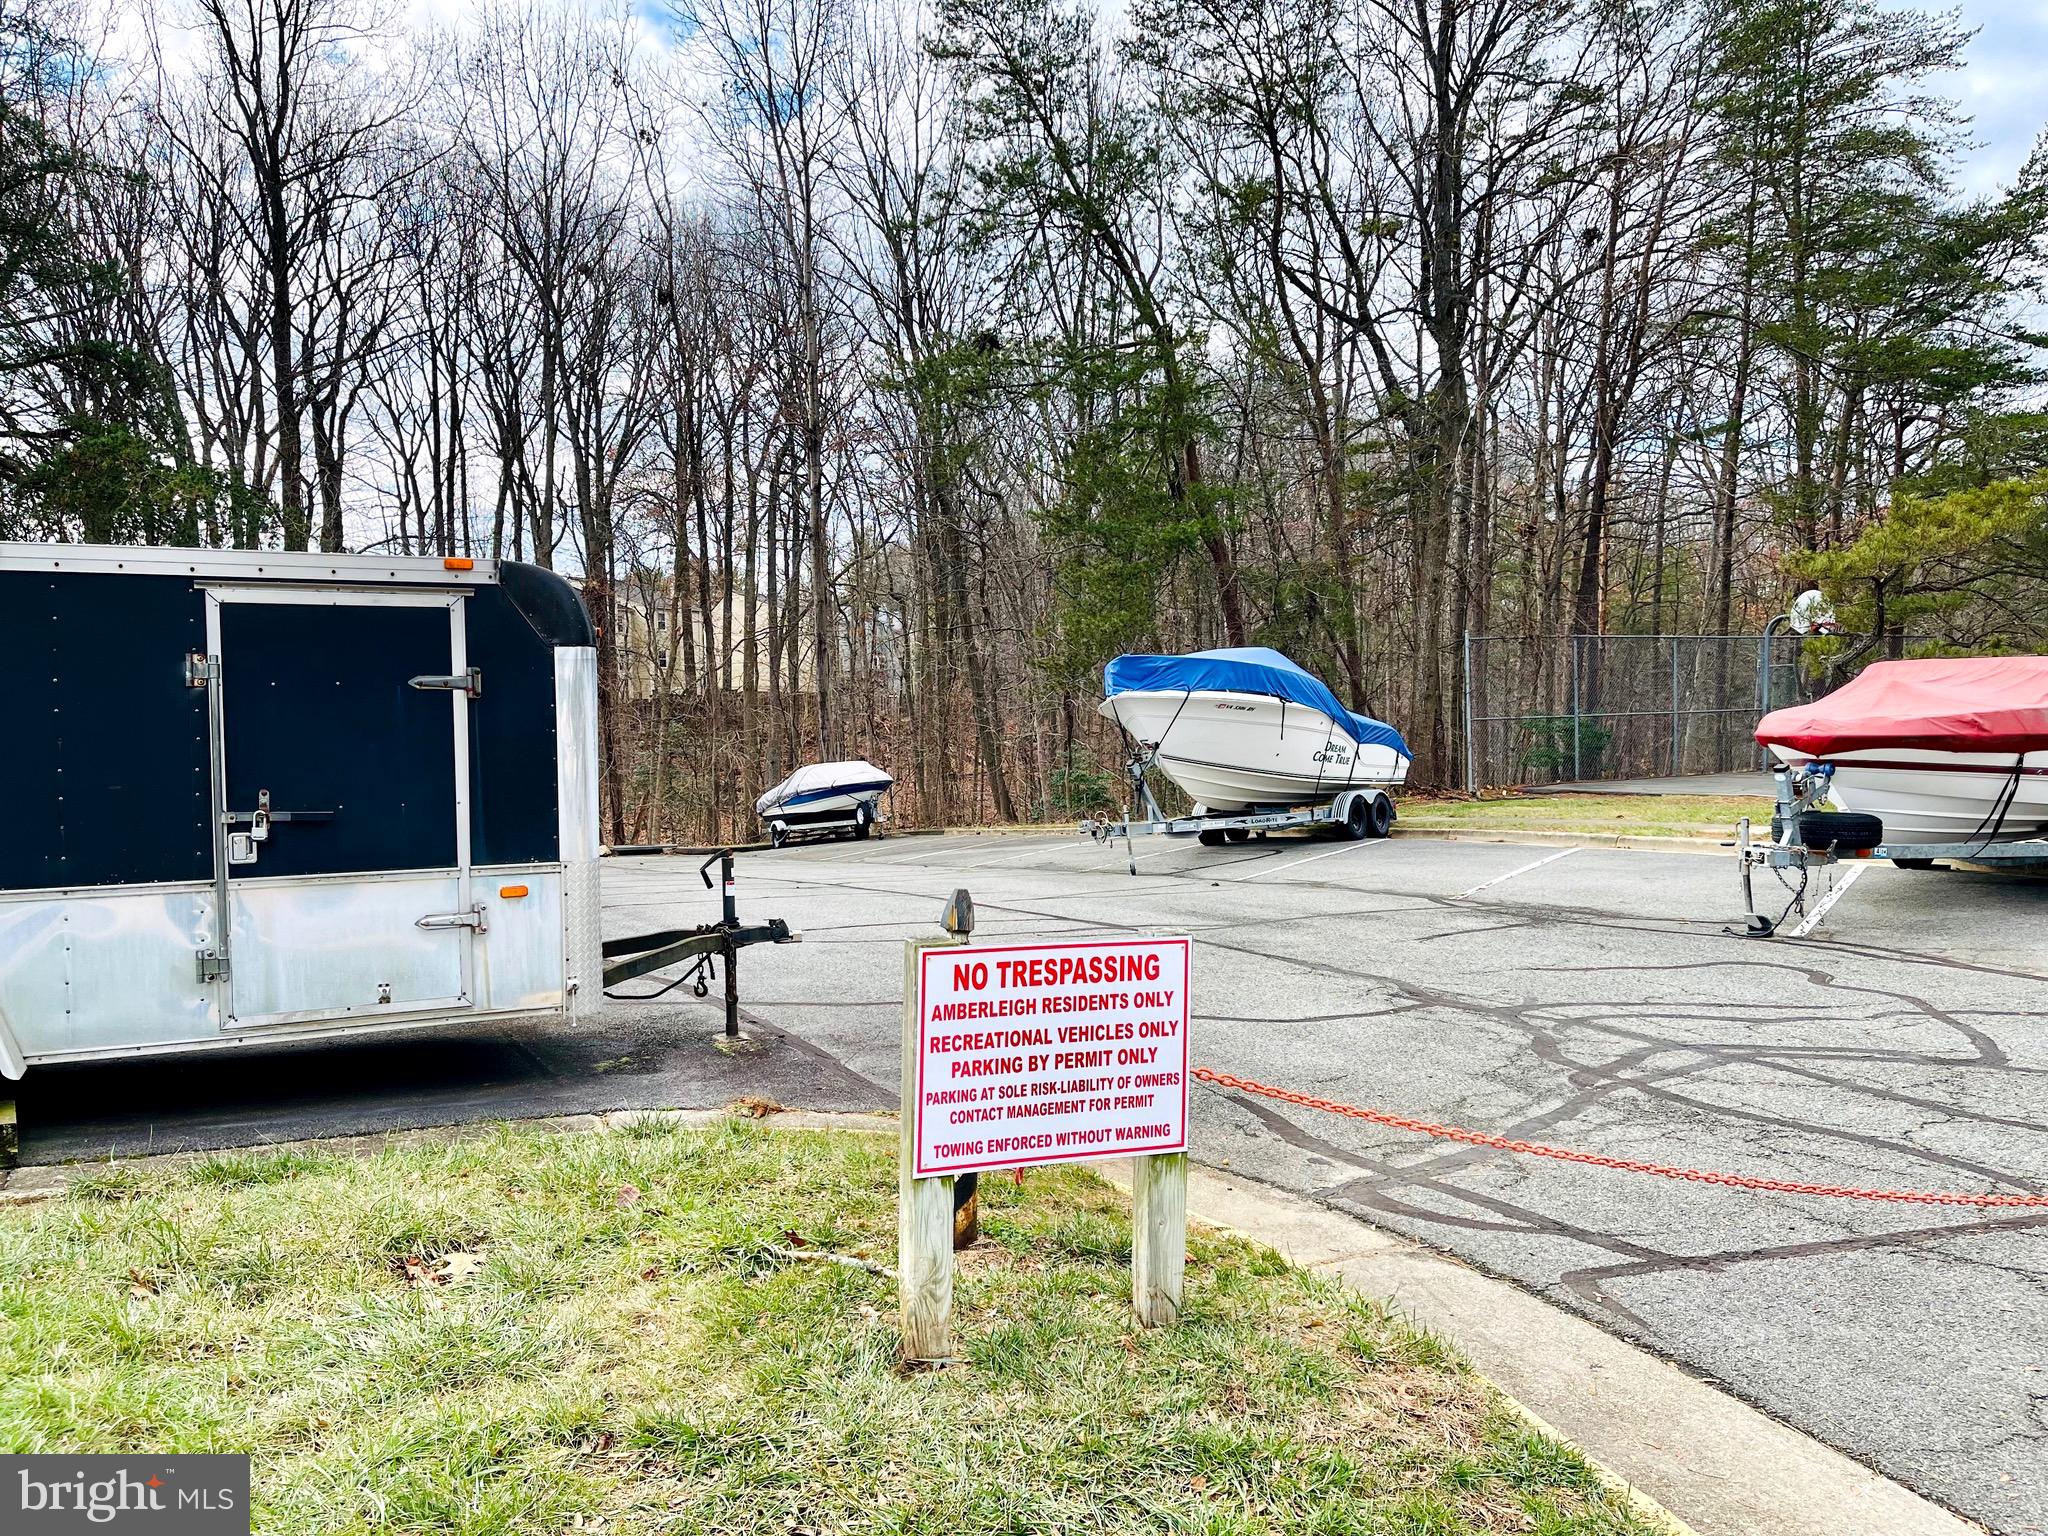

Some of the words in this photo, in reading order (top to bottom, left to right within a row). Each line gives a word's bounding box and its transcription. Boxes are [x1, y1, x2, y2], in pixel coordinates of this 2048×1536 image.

[1312, 751, 1334, 763] COME
[1335, 754, 1350, 765] TRUE
[1325, 741, 1347, 753] DREAM
[953, 962, 988, 992] NO
[996, 953, 1161, 988] TRESPASSING
[931, 998, 1037, 1022] AMBERLEIGH
[1042, 992, 1129, 1014] RESIDENTS
[1134, 991, 1174, 1008] ONLY
[930, 1029, 1053, 1054] RECREATIONAL
[1058, 1023, 1134, 1044] VEHICLES
[1138, 1020, 1179, 1039] ONLY
[951, 1056, 1023, 1079] PARKING
[1028, 1055, 1049, 1073] BY
[1055, 1050, 1113, 1070] PERMIT
[1118, 1047, 1158, 1066] ONLY
[926, 1087, 977, 1106] PARKING
[981, 1086, 995, 1101] AT
[998, 1084, 1028, 1099] SOLE
[1031, 1077, 1114, 1096] RISK-LIABILITY
[1117, 1076, 1131, 1089] OF
[1134, 1072, 1180, 1089] OWNERS
[950, 1107, 1004, 1125] CONTACT
[1007, 1100, 1086, 1119] MANAGEMENT
[1089, 1098, 1111, 1112] FOR
[1114, 1094, 1155, 1110] PERMIT
[933, 1140, 984, 1159] TOWING
[987, 1134, 1053, 1154] ENFORCED
[1056, 1128, 1112, 1147] WITHOUT
[1115, 1123, 1171, 1142] WARNING
